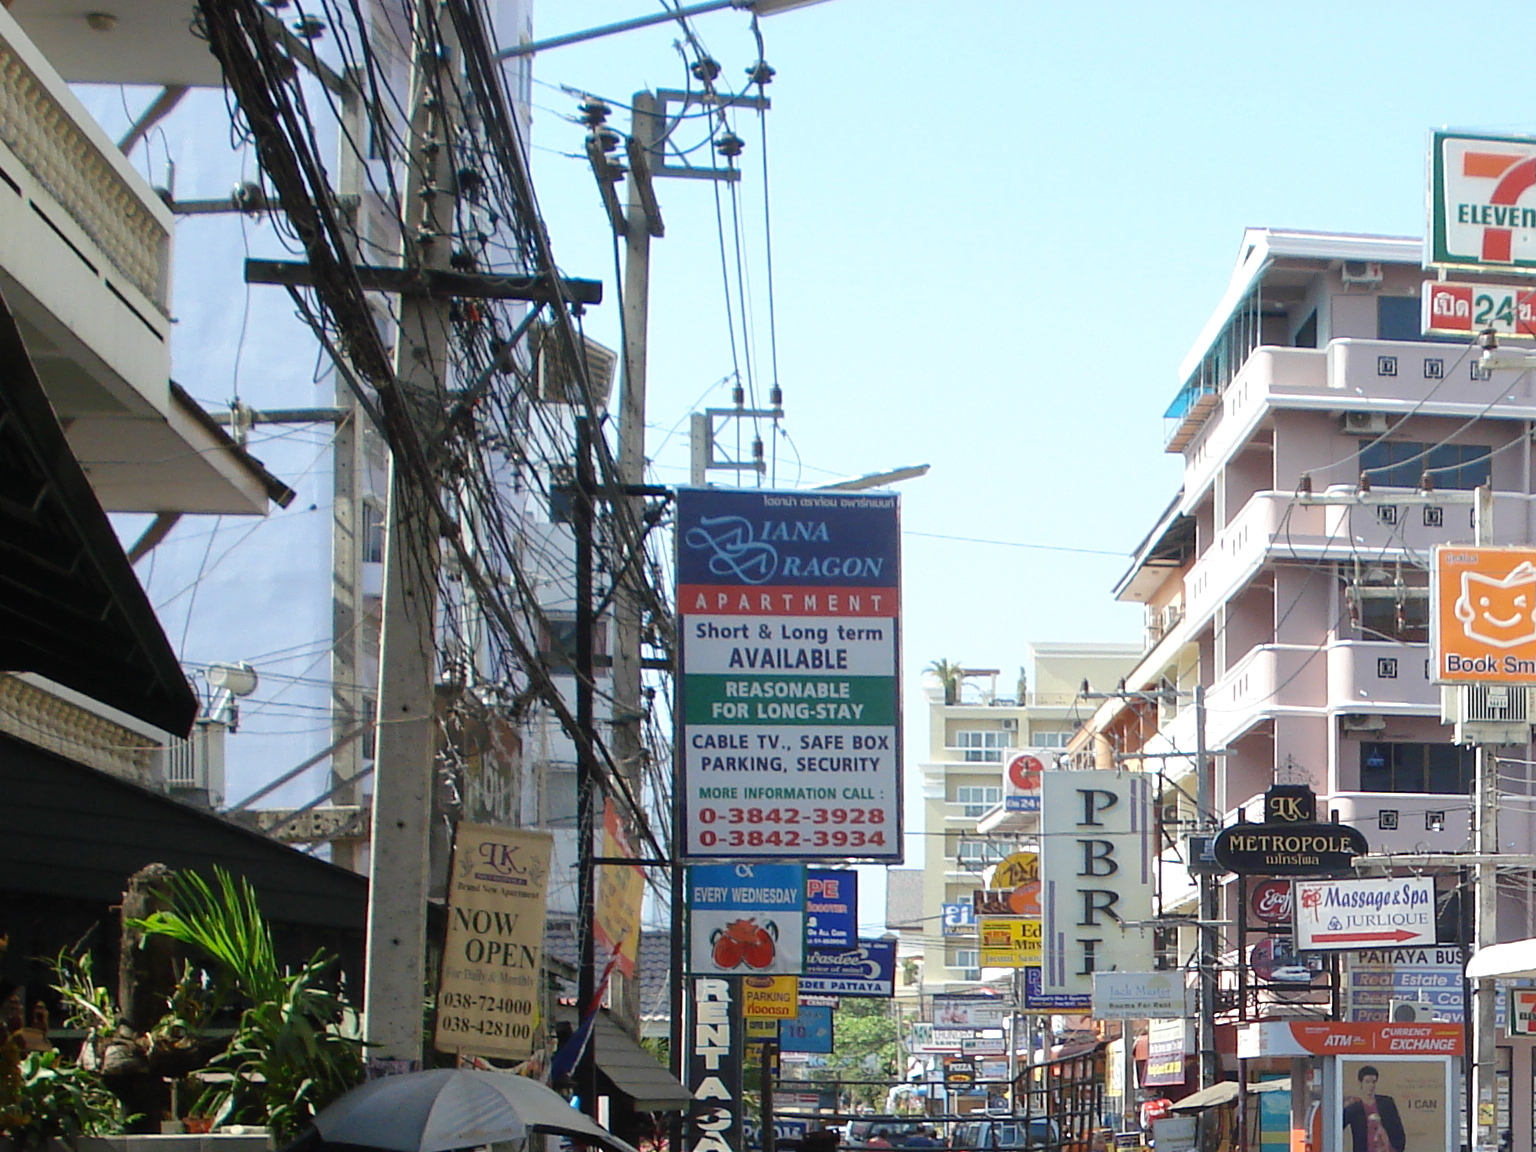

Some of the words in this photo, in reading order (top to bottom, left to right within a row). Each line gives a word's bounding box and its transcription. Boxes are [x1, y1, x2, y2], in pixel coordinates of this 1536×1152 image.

[1474, 293, 1515, 327] 24
[695, 592, 882, 612] APARTMENT
[696, 622, 749, 640] Short
[759, 624, 772, 640] &
[782, 624, 829, 644] Long
[837, 625, 884, 641] term
[729, 648, 848, 670] AVAILABLE
[1446, 653, 1498, 674] Book
[726, 681, 850, 698] REASONABLE
[712, 702, 749, 719] FOR
[757, 702, 864, 719] LONG-STAY
[692, 734, 749, 750] CABLE
[800, 735, 844, 750] SAFE
[853, 735, 889, 750] BOX
[701, 757, 788, 773] PARKING,
[797, 757, 881, 773] SECURITY
[699, 787, 738, 799] MORE
[744, 787, 837, 799] INFORMATION
[843, 787, 875, 800] CALL
[699, 807, 885, 824] 0-3842-3928
[699, 830, 886, 847] 0-3842-3934
[1229, 835, 1351, 854] METROPOLE
[694, 887, 728, 902] EVERY
[732, 887, 797, 903] WEDNESDAY
[1325, 887, 1391, 911] Massage
[1403, 884, 1429, 910] Spa
[453, 906, 519, 936] NOW
[1346, 913, 1429, 928] JURLIQUE
[465, 938, 539, 970] OPEN
[1358, 950, 1428, 965] PATTAYA
[831, 982, 882, 991] PATTAYA
[1359, 973, 1395, 986] Real
[1401, 973, 1448, 987] Estate
[443, 992, 532, 1016] 038-724000
[747, 991, 790, 1003] PARKING
[442, 1015, 531, 1040] 038-428100
[695, 977, 733, 1070] RENT
[1324, 1034, 1352, 1047] ATM
[1381, 1027, 1432, 1038] CURRENCY
[1390, 1039, 1457, 1050] EXCHANGE
[694, 1076, 733, 1100] A
[1414, 1099, 1437, 1110] CAN
